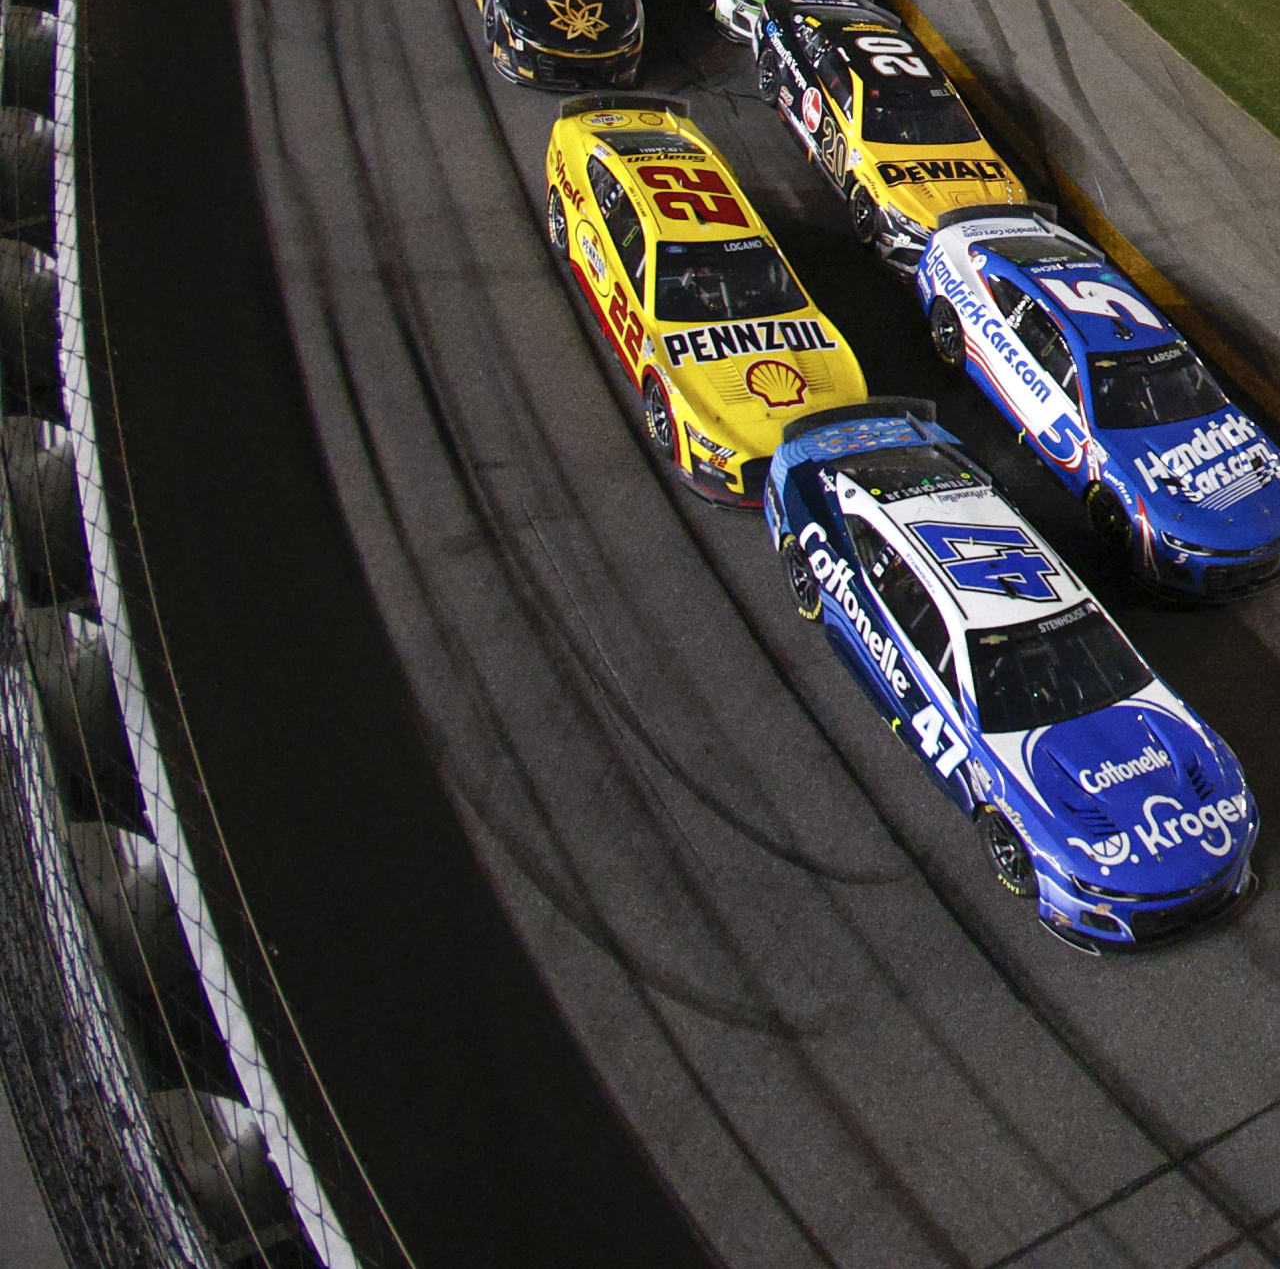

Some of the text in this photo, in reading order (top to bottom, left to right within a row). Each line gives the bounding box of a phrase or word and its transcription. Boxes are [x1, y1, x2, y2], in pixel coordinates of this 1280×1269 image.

[515, 39, 524, 52] 8
[855, 36, 932, 78] 20
[821, 115, 849, 188] 20
[556, 149, 585, 212] Shell
[636, 165, 750, 228] 22
[723, 239, 763, 253] LOGANO
[895, 233, 911, 246] 20
[608, 281, 645, 368] 22
[1038, 277, 1167, 332] 5
[663, 318, 839, 367] PENNZOIL
[1147, 347, 1183, 365] LARSON
[708, 454, 728, 468] 22
[1036, 413, 1088, 472] 5
[1134, 414, 1257, 494] Hendrick
[1181, 442, 1275, 502] Cars.com
[907, 521, 1061, 602] 47
[1174, 552, 1188, 565] 5
[799, 521, 912, 699] Cottonelle
[1038, 607, 1087, 634] STENHOUSE
[911, 702, 970, 779] 47
[1079, 746, 1171, 794] Cottonelle
[1133, 795, 1251, 857] Kroger
